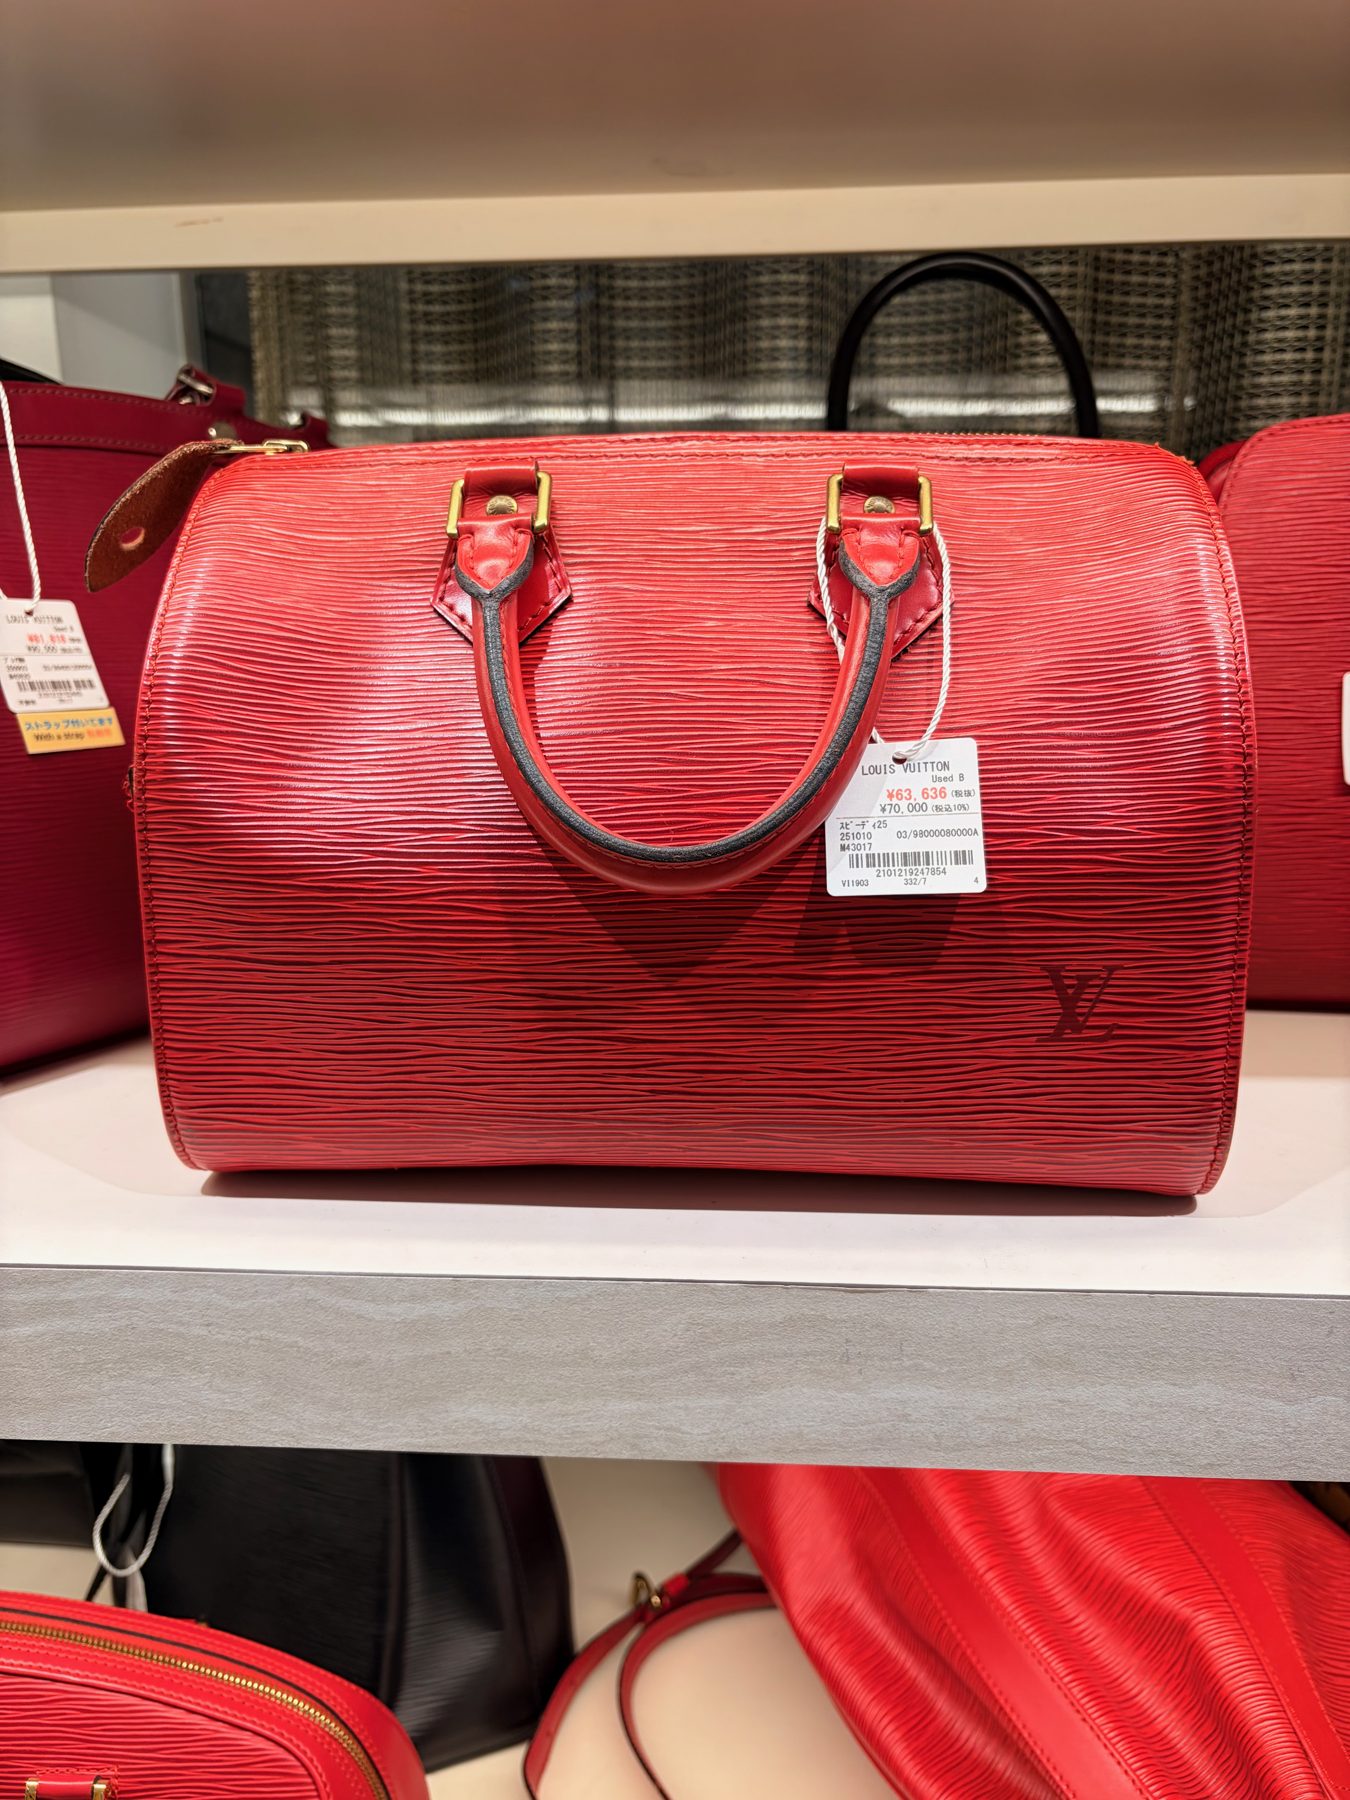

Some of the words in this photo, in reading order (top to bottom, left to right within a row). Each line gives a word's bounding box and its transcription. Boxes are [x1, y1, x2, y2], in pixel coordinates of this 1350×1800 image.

[862, 764, 896, 776] LOUIS
[902, 761, 950, 774] VUITTON
[932, 774, 954, 783] Used
[958, 773, 965, 782] B
[886, 786, 948, 802] ¥63,636
[880, 802, 928, 815] ¥70,000
[839, 832, 873, 841] 251010
[896, 828, 979, 840] 03/98000080000A
[839, 843, 873, 852] M43017
[876, 867, 947, 878] 2101219247854
[903, 877, 928, 886] 332/7
[973, 876, 979, 885] 4
